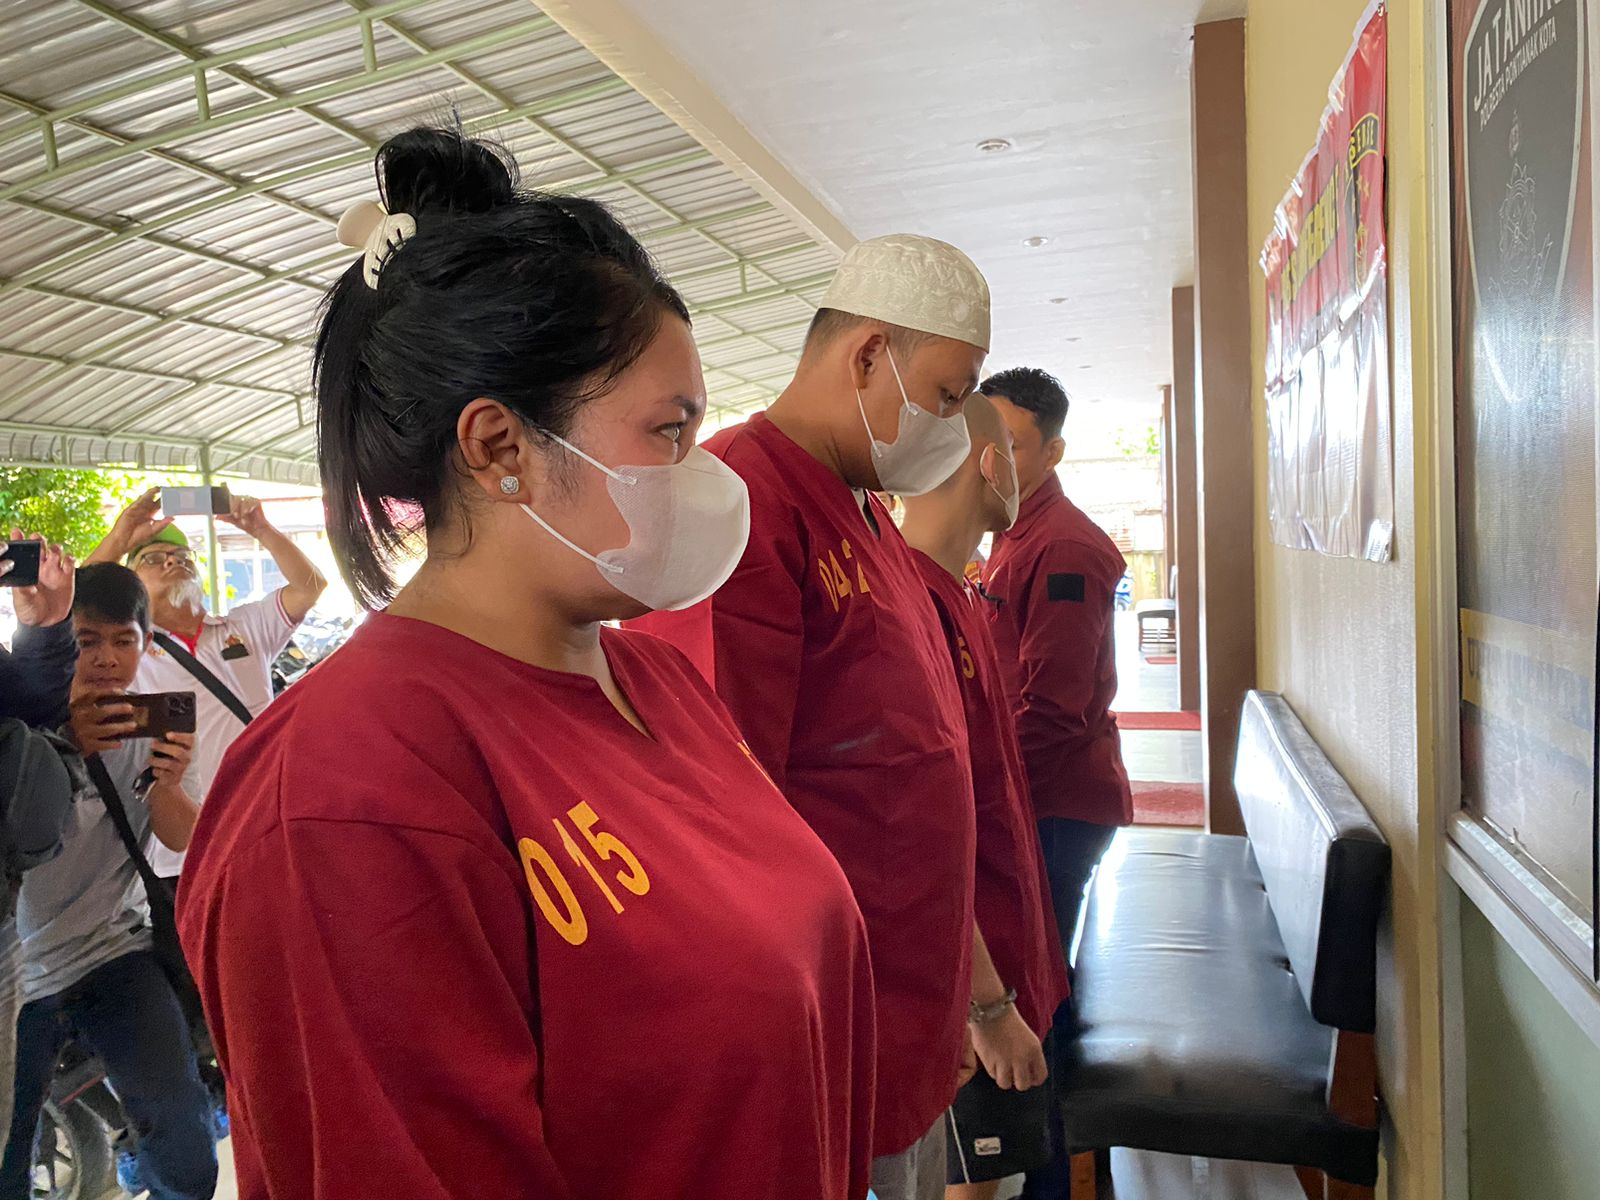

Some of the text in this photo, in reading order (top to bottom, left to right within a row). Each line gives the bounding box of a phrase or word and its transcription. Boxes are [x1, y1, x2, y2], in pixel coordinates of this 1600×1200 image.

[1474, 0, 1560, 112] JATAN
[1505, 31, 1539, 91] PONTIANAK
[1539, 15, 1558, 54] KOTA
[517, 799, 651, 946] 015
